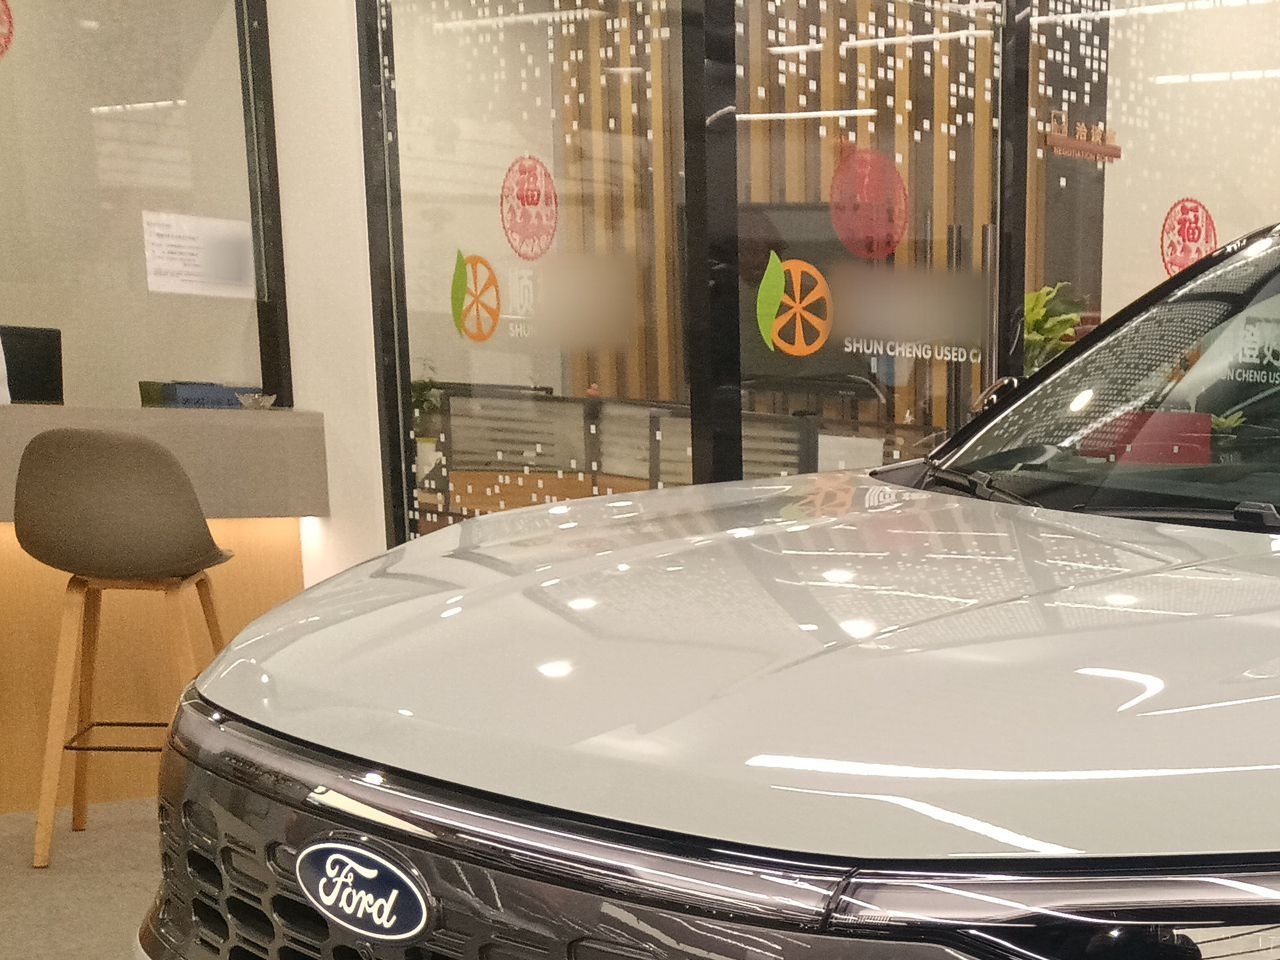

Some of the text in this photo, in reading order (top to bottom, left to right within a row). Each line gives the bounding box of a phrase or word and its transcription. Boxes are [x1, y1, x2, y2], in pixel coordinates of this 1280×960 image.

[508, 321, 533, 338] SHU
[843, 337, 982, 364] SHUN CHENG USED C
[1235, 368, 1268, 384] CHENG
[318, 853, 399, 929] Ford
